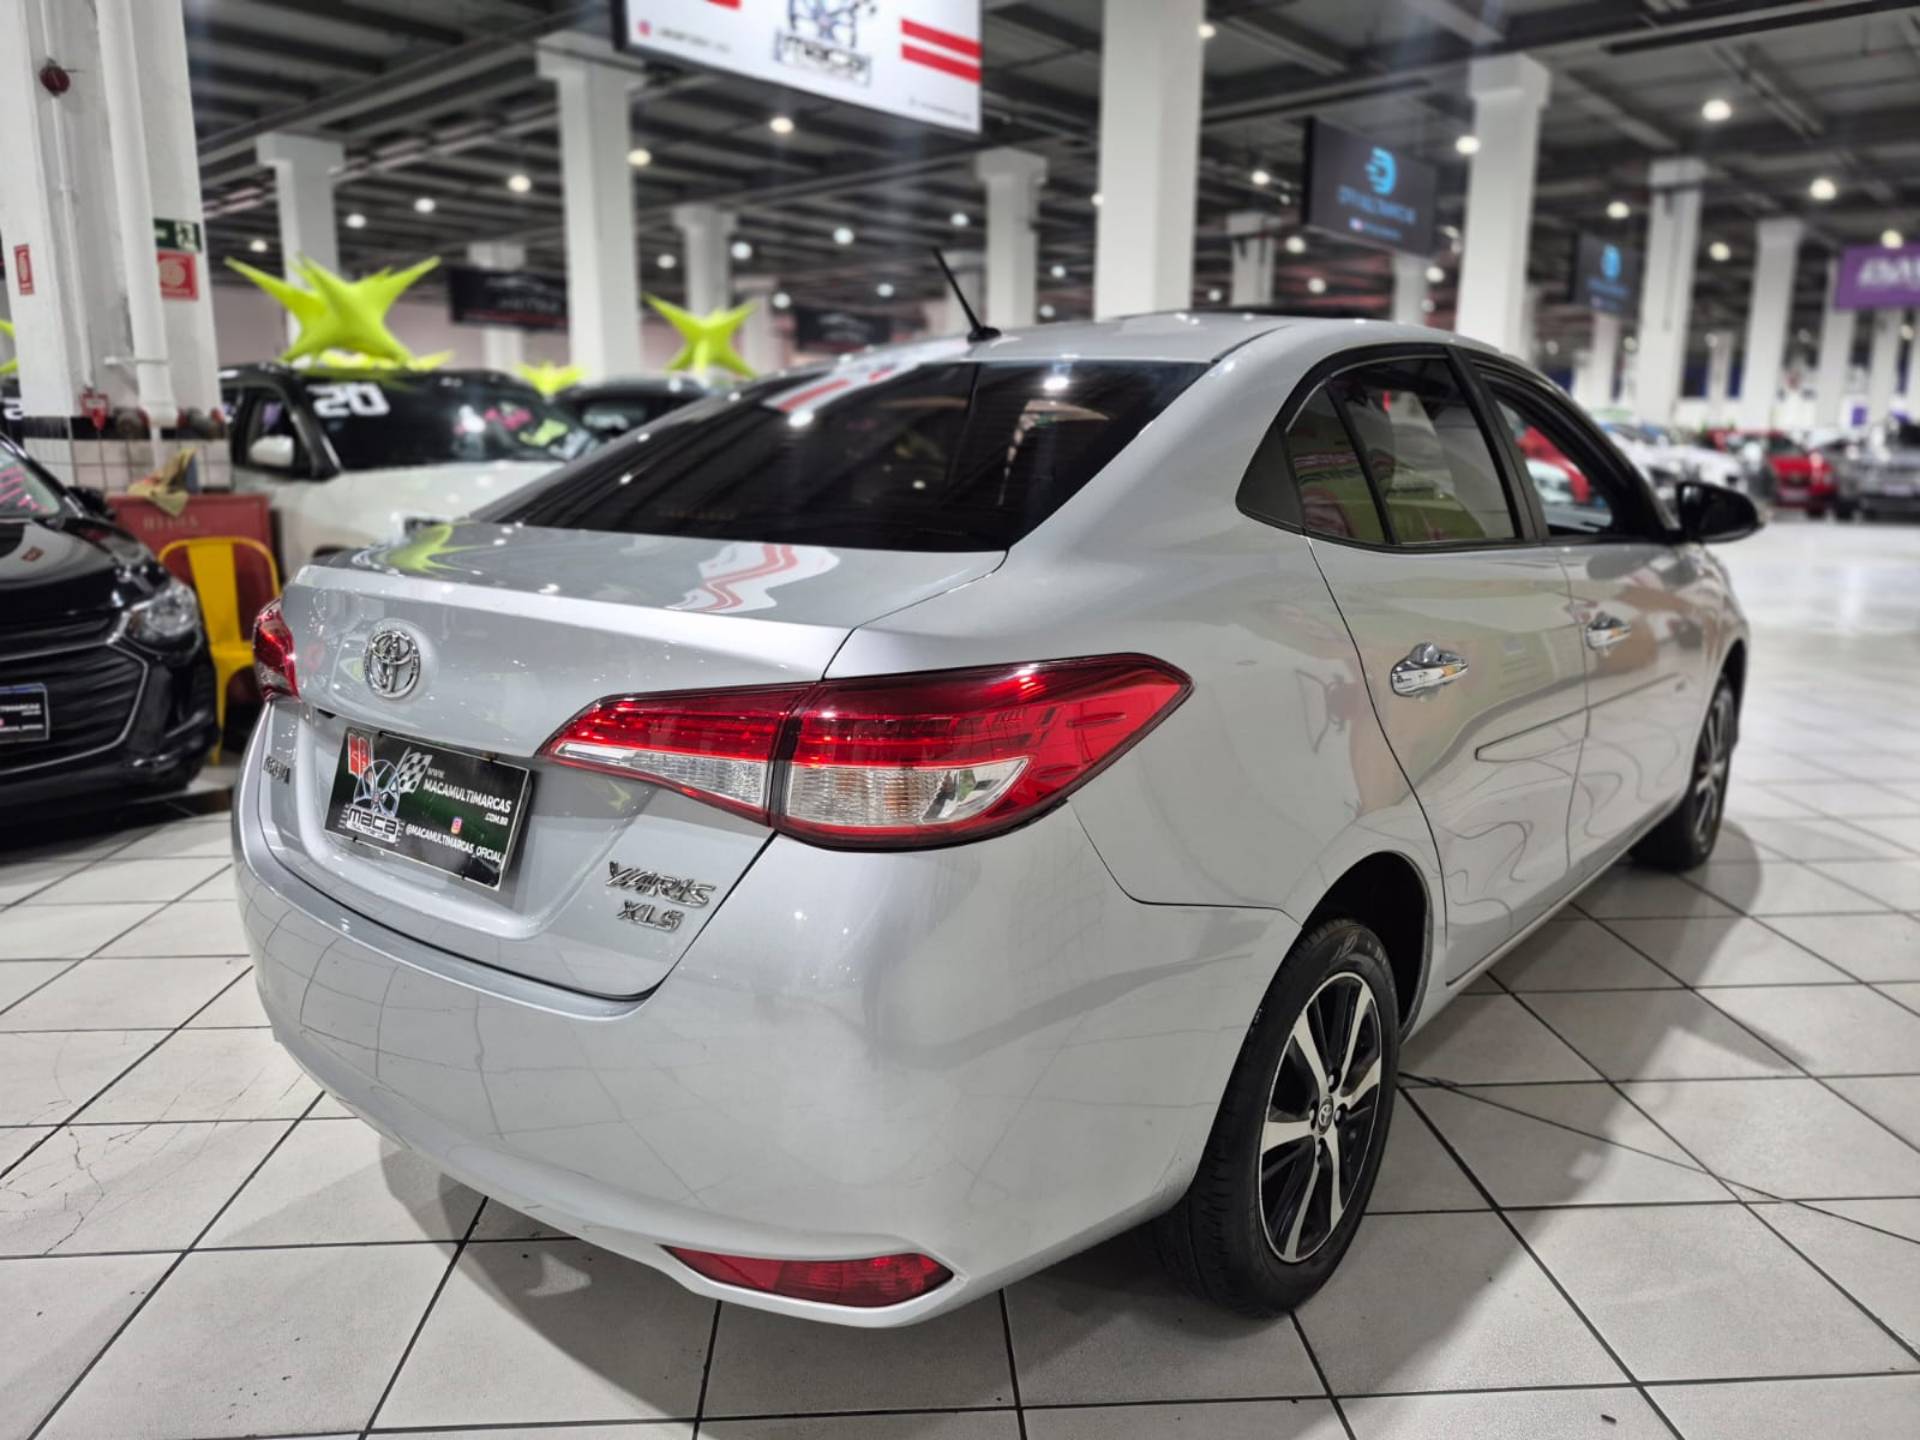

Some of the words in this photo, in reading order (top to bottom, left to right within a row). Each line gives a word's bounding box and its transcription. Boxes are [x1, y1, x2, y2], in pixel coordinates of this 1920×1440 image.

[422, 778, 512, 813] MACAMULTIMARCAS
[606, 860, 717, 908] YARIS
[616, 899, 685, 933] XLS
